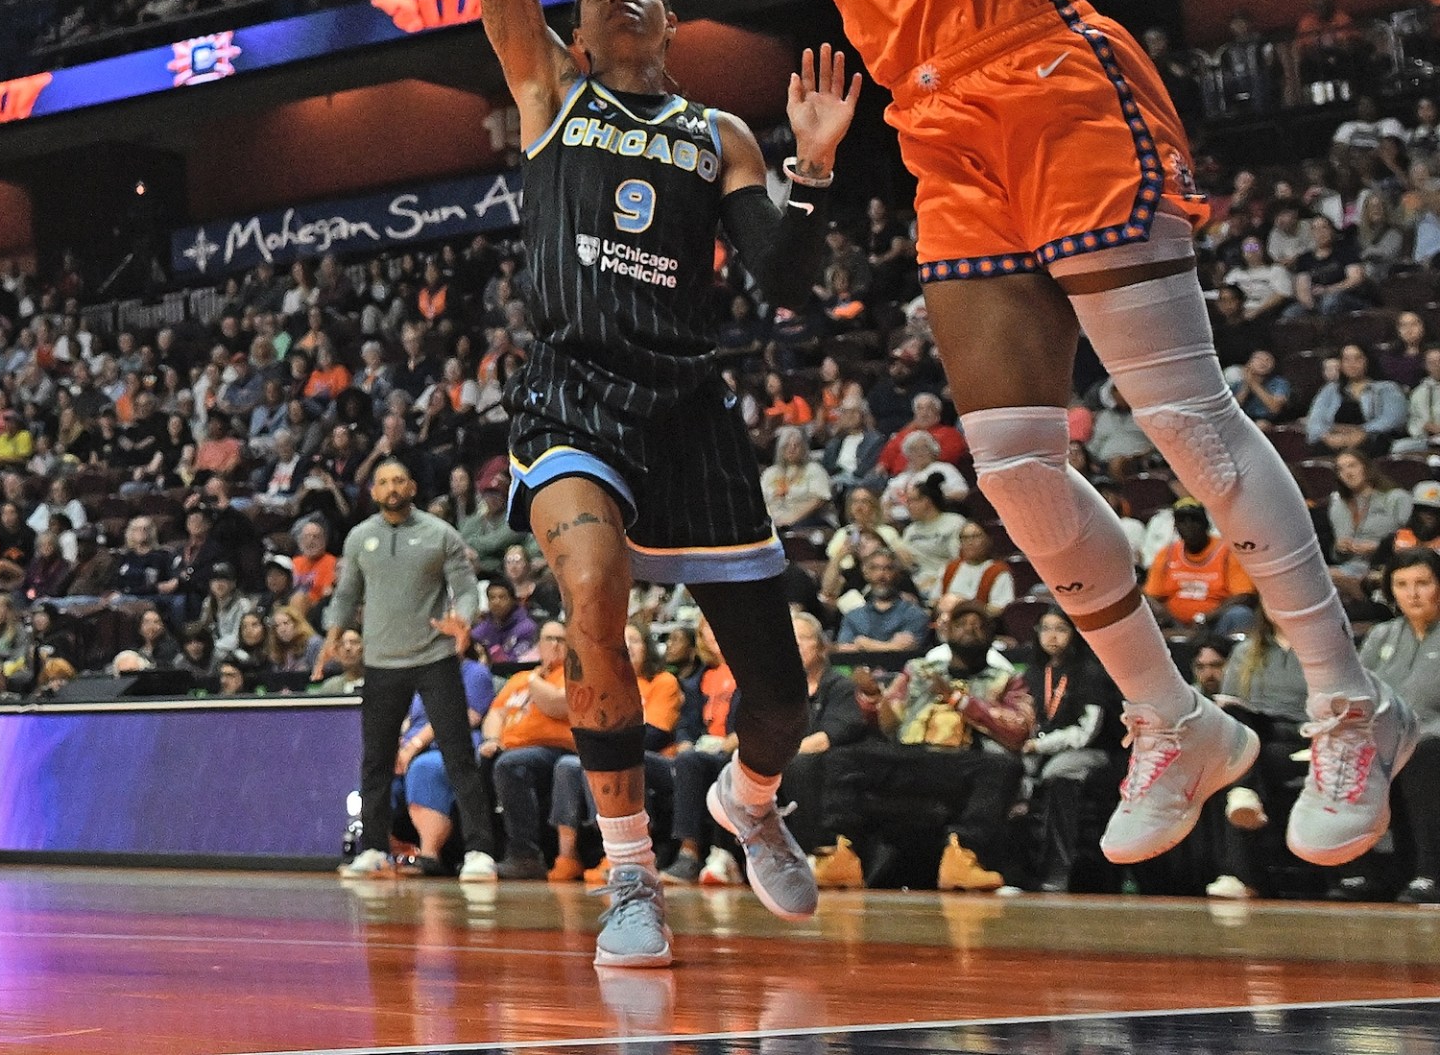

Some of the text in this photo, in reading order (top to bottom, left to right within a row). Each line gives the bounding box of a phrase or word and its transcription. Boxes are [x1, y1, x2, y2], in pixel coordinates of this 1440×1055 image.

[562, 117, 720, 184] CHICAGO
[224, 206, 381, 265] Mohegan
[384, 193, 467, 240] Sun
[613, 178, 657, 234] 9
[600, 255, 678, 289] Medicine
[602, 239, 679, 272] UChicago
